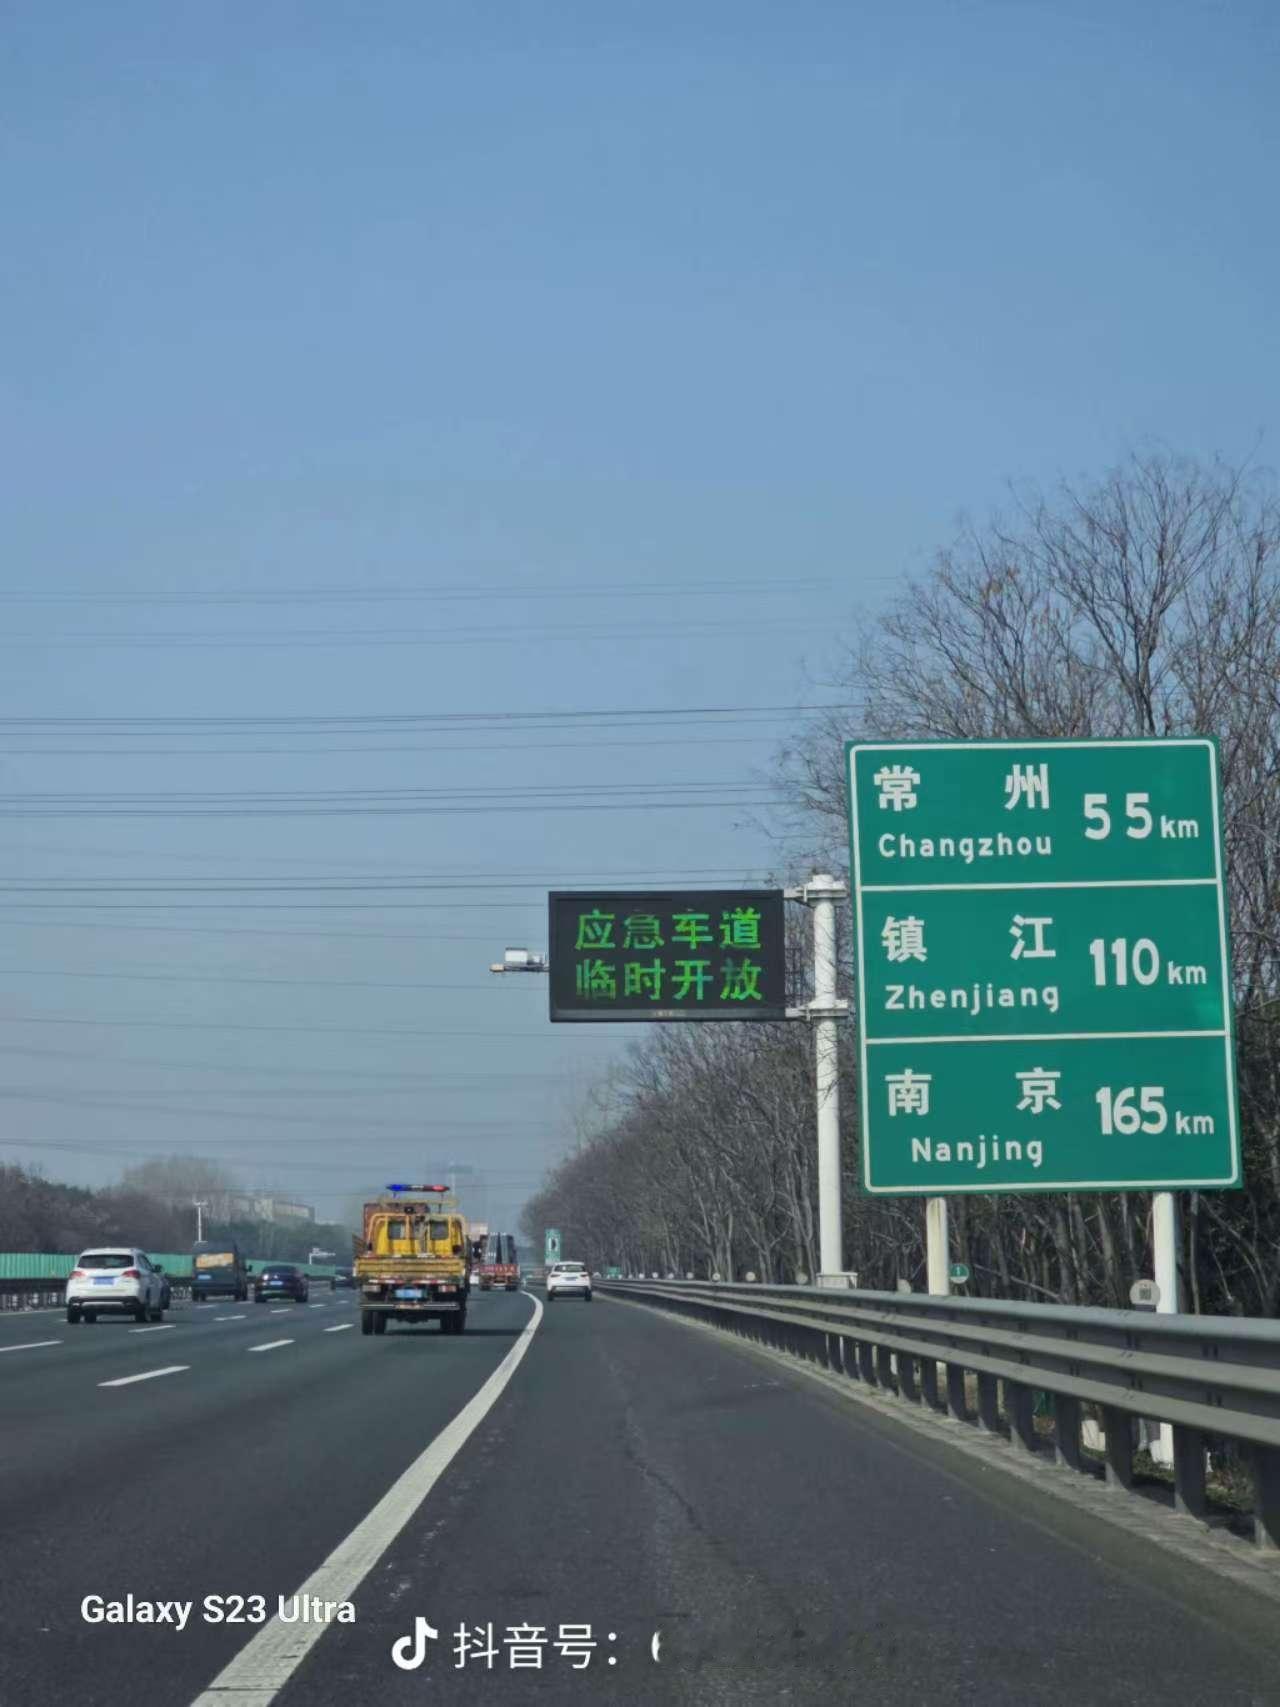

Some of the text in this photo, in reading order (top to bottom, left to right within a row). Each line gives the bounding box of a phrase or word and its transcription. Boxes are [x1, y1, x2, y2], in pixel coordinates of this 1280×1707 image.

[873, 764, 1050, 812] 常州
[1083, 793, 1199, 841] 55 km
[878, 832, 1052, 864] Changzhou
[575, 908, 762, 950] 应急车道
[881, 914, 1057, 963] 镇江
[575, 957, 763, 1001] 临时开放
[1089, 937, 1207, 986] 110 km
[885, 983, 1059, 1016] Zhenjiang
[884, 1067, 1062, 1117] 南京
[1095, 1086, 1215, 1135] 165 km
[911, 1134, 1043, 1169] Nanjing
